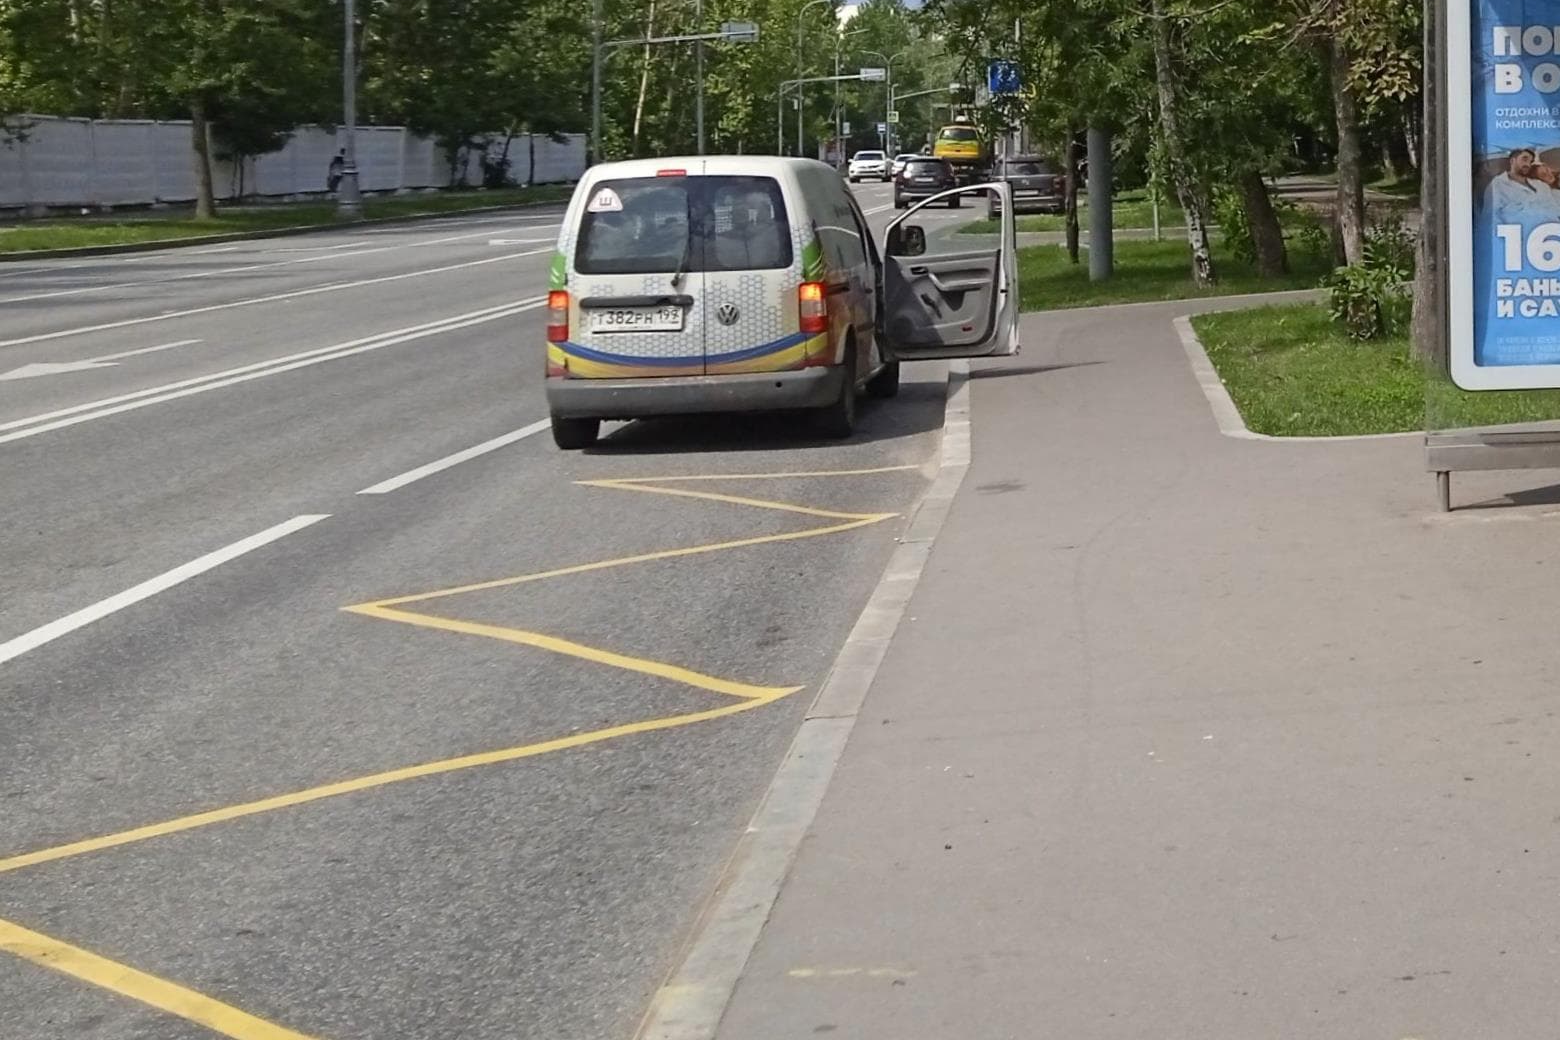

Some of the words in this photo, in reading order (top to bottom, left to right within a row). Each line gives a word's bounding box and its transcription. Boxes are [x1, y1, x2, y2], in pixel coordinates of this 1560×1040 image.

[1494, 63, 1523, 94] В
[1495, 107, 1549, 118] ОТДОХНИ
[1496, 299, 1517, 318] И
